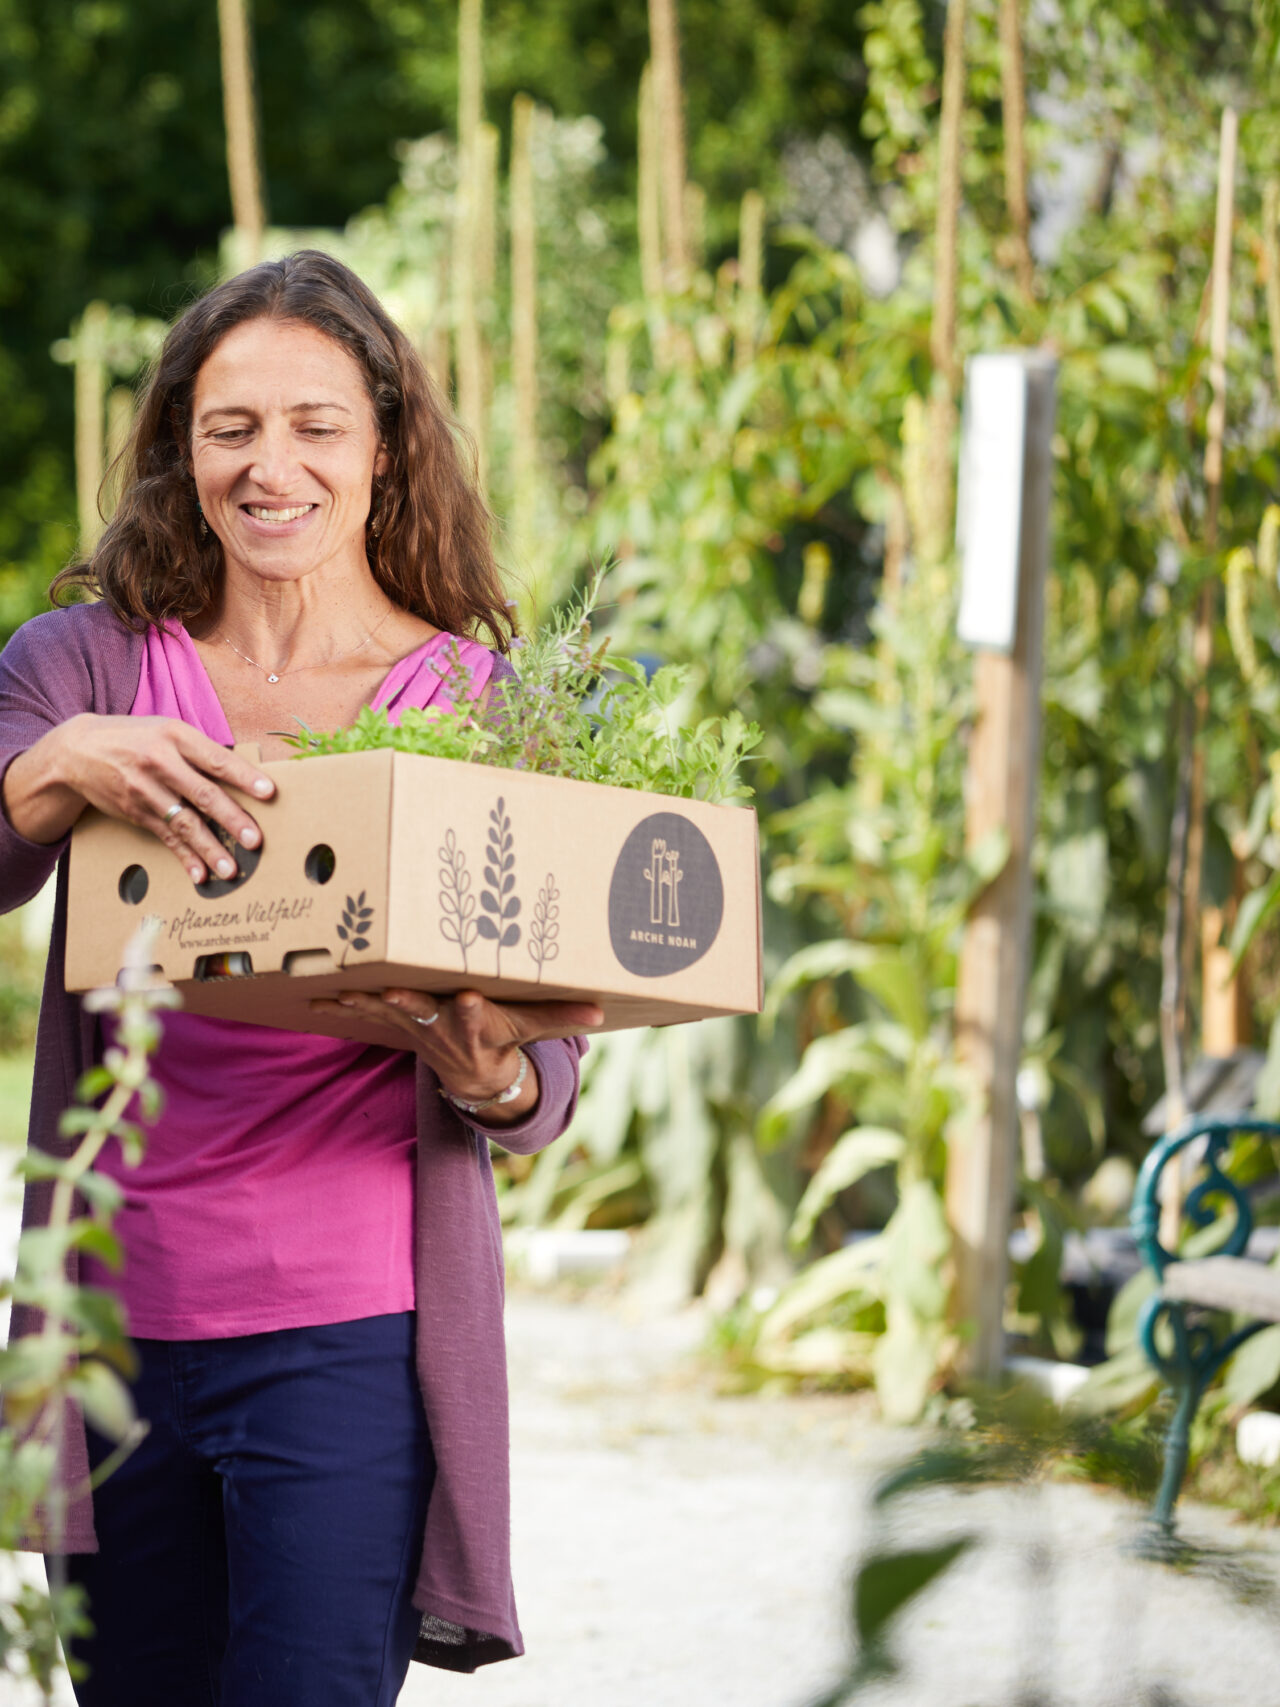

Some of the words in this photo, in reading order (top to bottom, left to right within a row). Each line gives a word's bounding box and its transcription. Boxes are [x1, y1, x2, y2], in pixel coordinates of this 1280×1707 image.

[169, 908, 241, 941] pflanzen
[245, 898, 313, 930] Vielfalt!
[179, 931, 270, 949] www.arche-noah.at
[630, 930, 665, 944] ARCHE
[668, 936, 697, 949] NOAH
